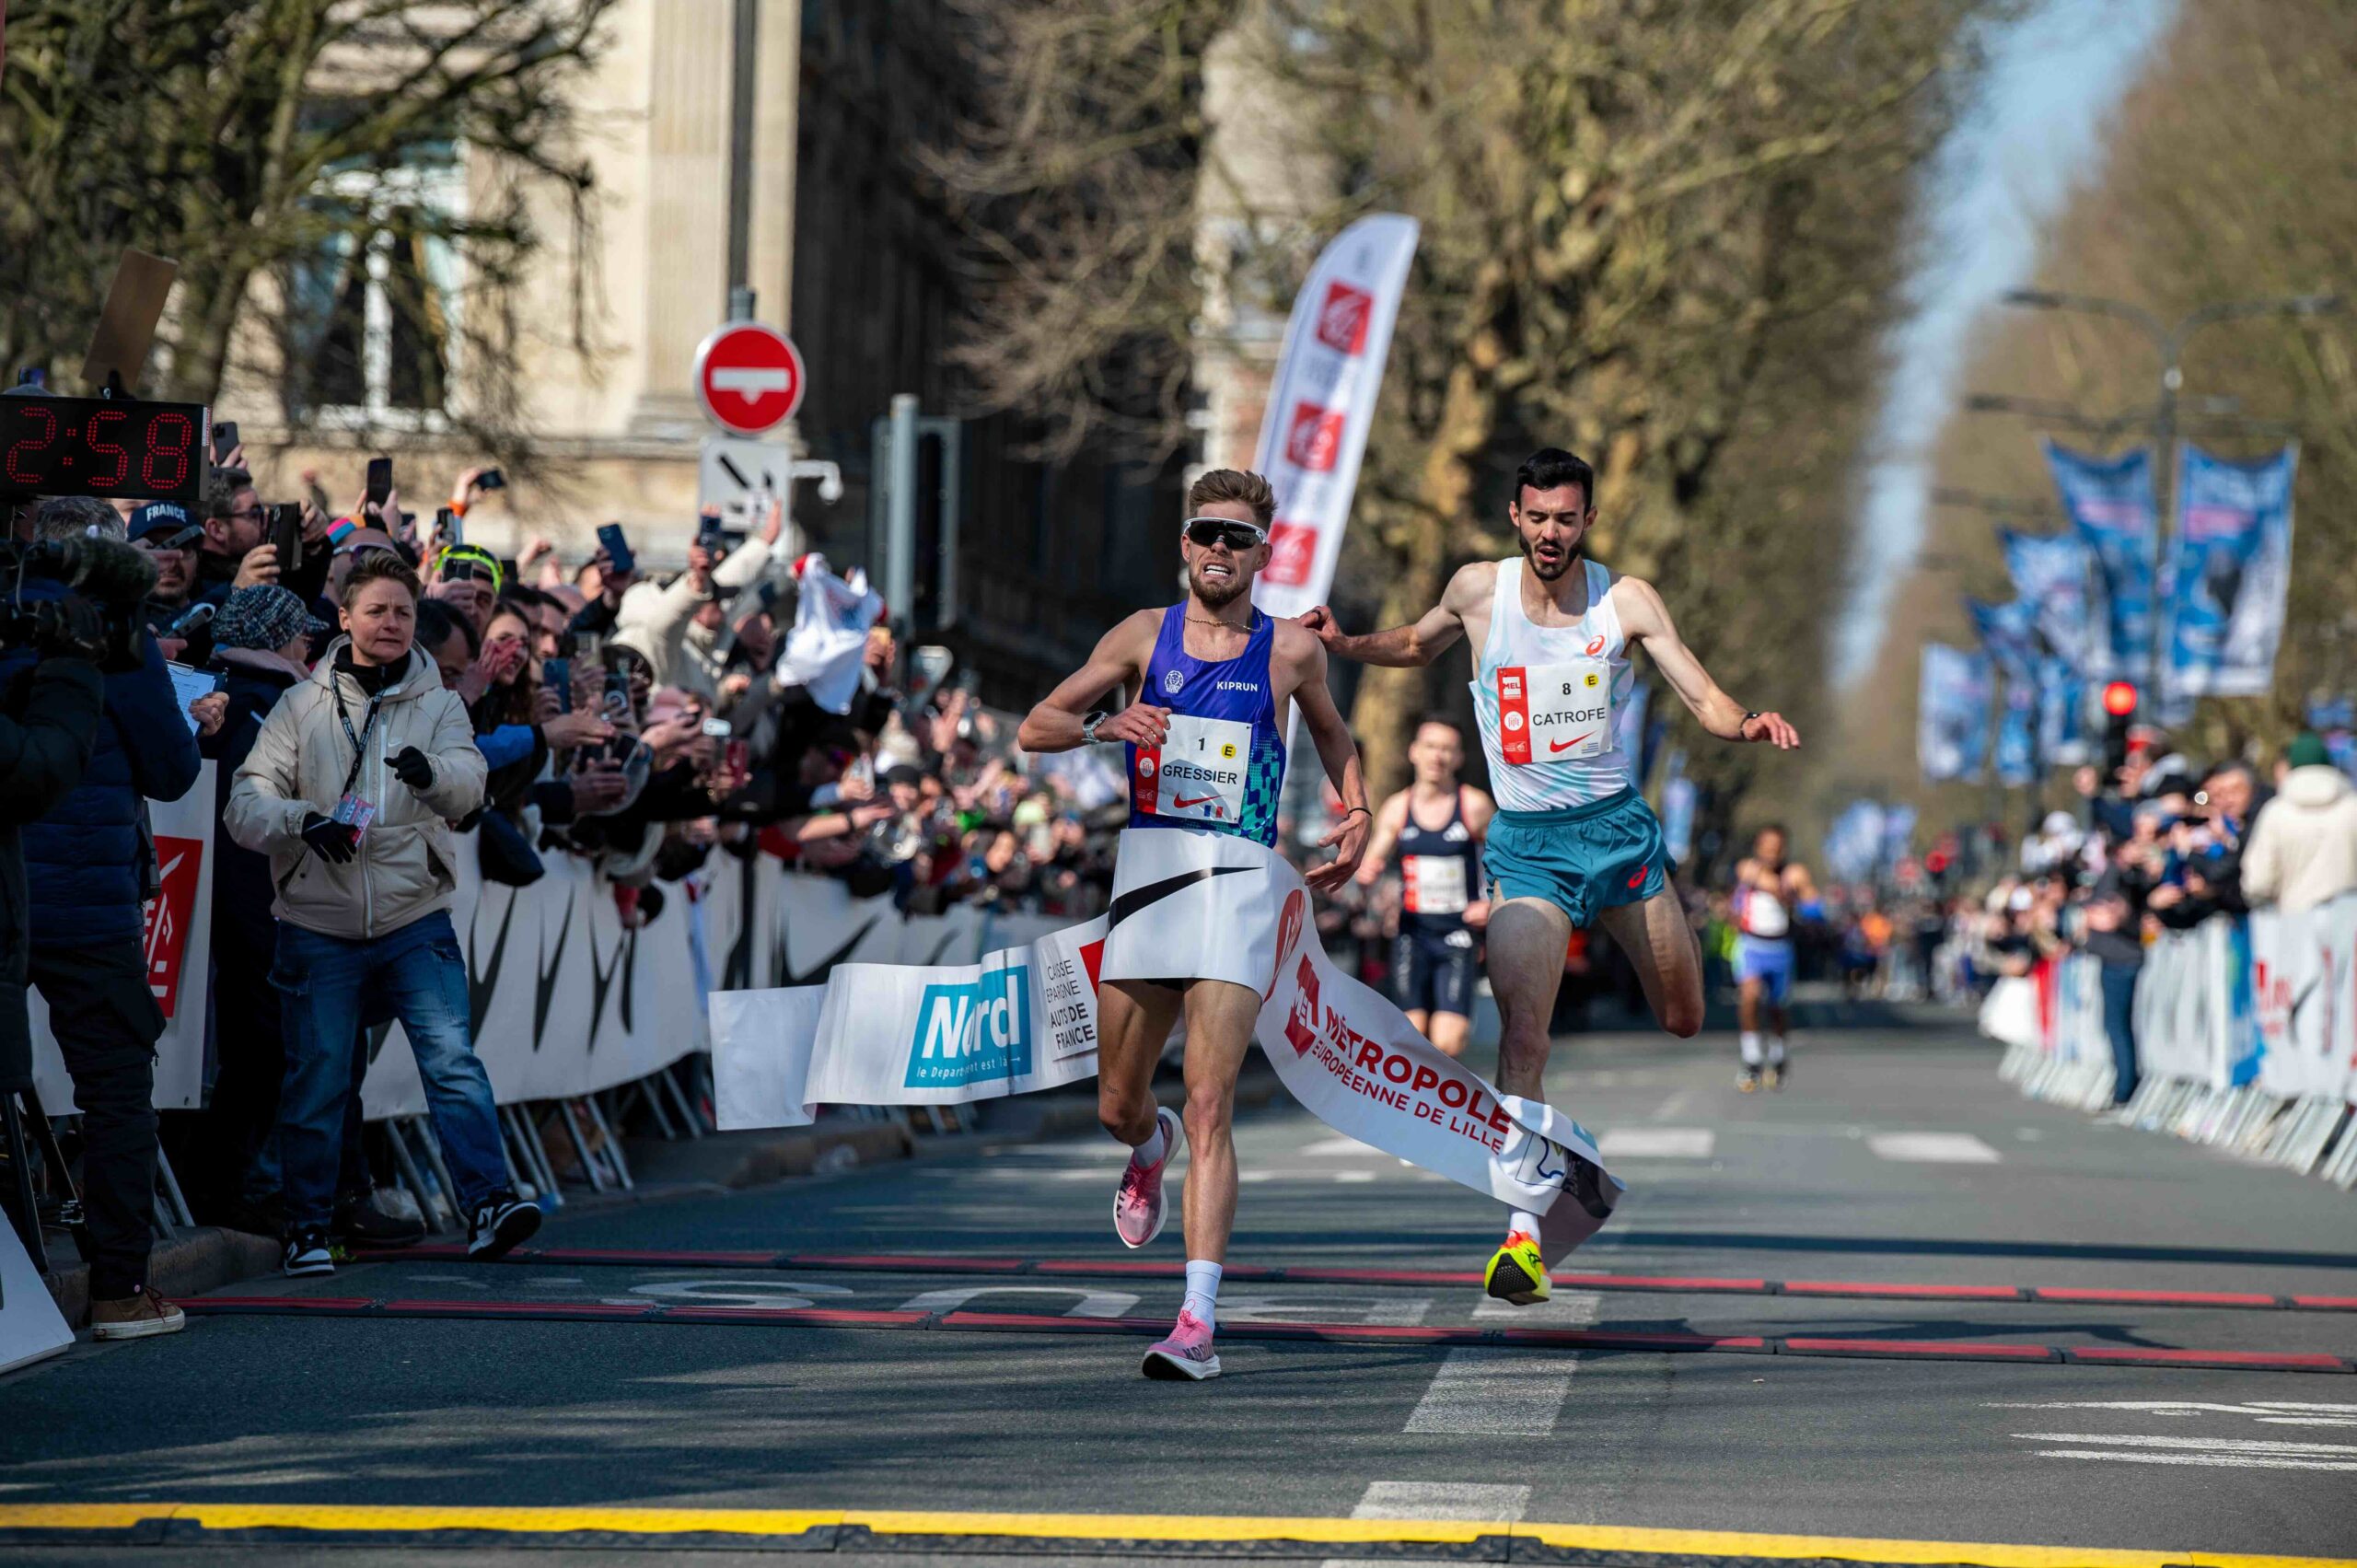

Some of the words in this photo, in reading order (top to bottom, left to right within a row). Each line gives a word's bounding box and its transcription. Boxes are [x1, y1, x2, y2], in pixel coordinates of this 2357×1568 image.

[6, 406, 193, 490] 2:58
[145, 503, 187, 522] FRANCE
[1216, 680, 1259, 691] KIPRUN
[1562, 682, 1572, 696] 8
[1587, 675, 1596, 686] E
[1532, 707, 1606, 726] CATROFE
[1198, 738, 1206, 751] 1
[1224, 745, 1234, 757] E
[1162, 764, 1238, 784] GRESSIER
[1047, 959, 1074, 981] CAISSE
[922, 974, 1020, 1059] Nord
[1050, 1008, 1069, 1028] AUTS
[1068, 1002, 1088, 1022] DE
[1055, 1024, 1096, 1050] FRANCE
[916, 1065, 927, 1077] le
[981, 1058, 995, 1070] est
[1325, 1005, 1512, 1135] MÉTROPOLE
[1312, 1040, 1411, 1112] EUROPÉENNE
[1414, 1101, 1446, 1125] DE
[1449, 1115, 1504, 1156] LILLE
